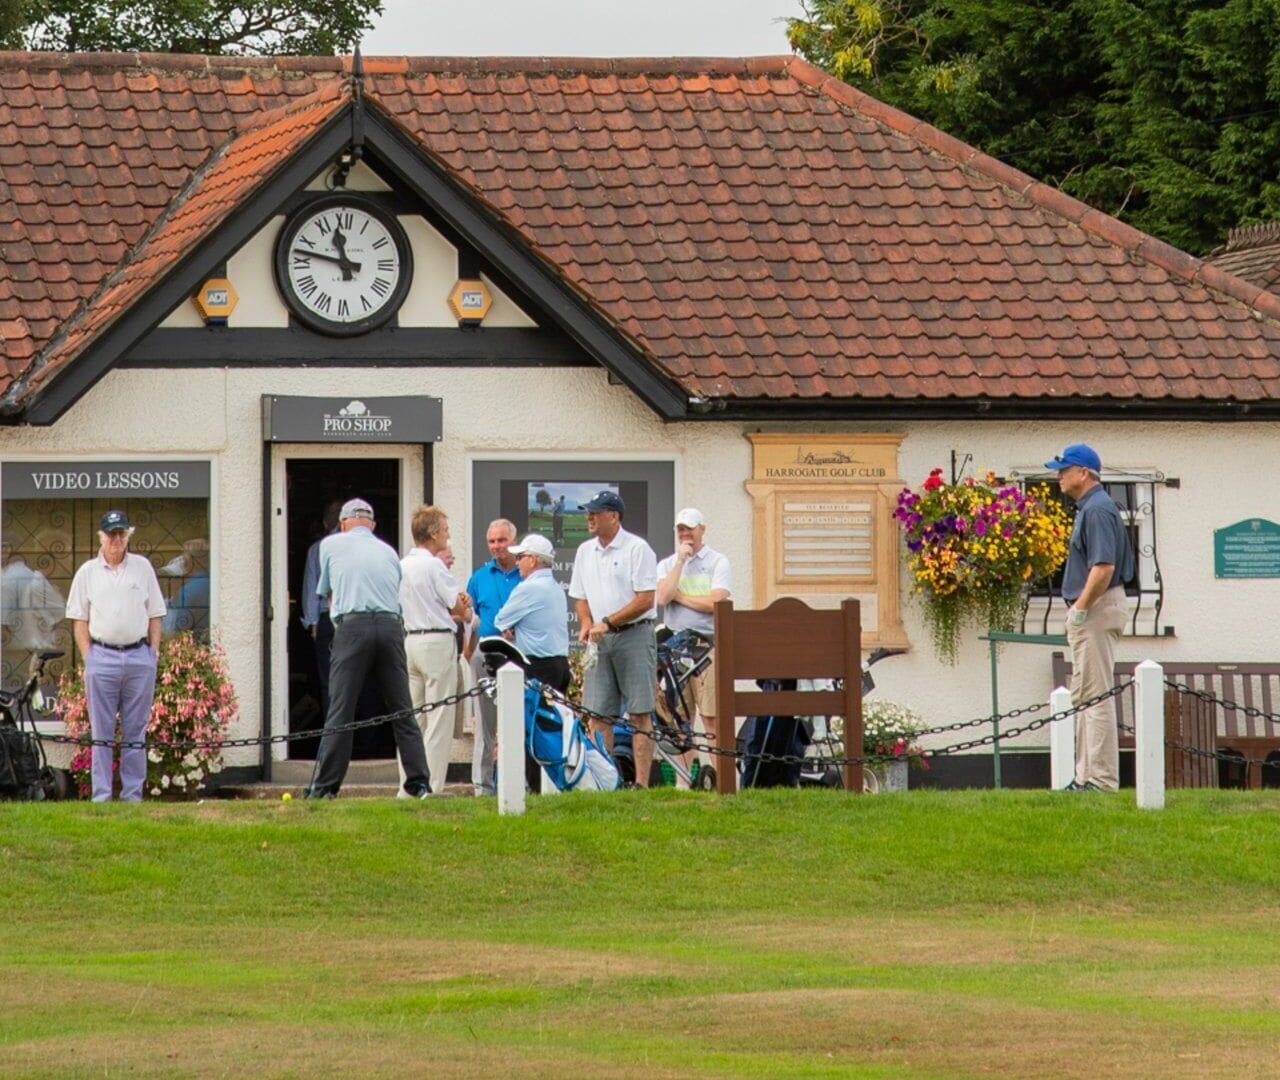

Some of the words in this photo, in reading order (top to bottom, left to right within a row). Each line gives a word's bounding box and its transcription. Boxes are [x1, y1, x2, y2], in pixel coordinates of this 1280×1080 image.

[314, 216, 331, 236] XI
[336, 213, 353, 230] XII
[360, 220, 369, 235] I
[299, 235, 316, 249] X
[372, 236, 388, 250] II
[294, 257, 310, 270] IX
[377, 259, 394, 271] III
[296, 275, 318, 299] VIII
[370, 277, 391, 298] IIII
[314, 292, 332, 313] VII
[360, 295, 372, 311] V
[463, 293, 482, 306] ADT
[338, 299, 349, 316] VI
[323, 418, 352, 431] PRO
[353, 418, 392, 431] SHOP
[765, 468, 827, 478] HARROGATE
[829, 468, 856, 478] GOLF
[858, 468, 886, 478] CLUB
[31, 472, 91, 490] VIDEO
[95, 472, 180, 490] LESSONS
